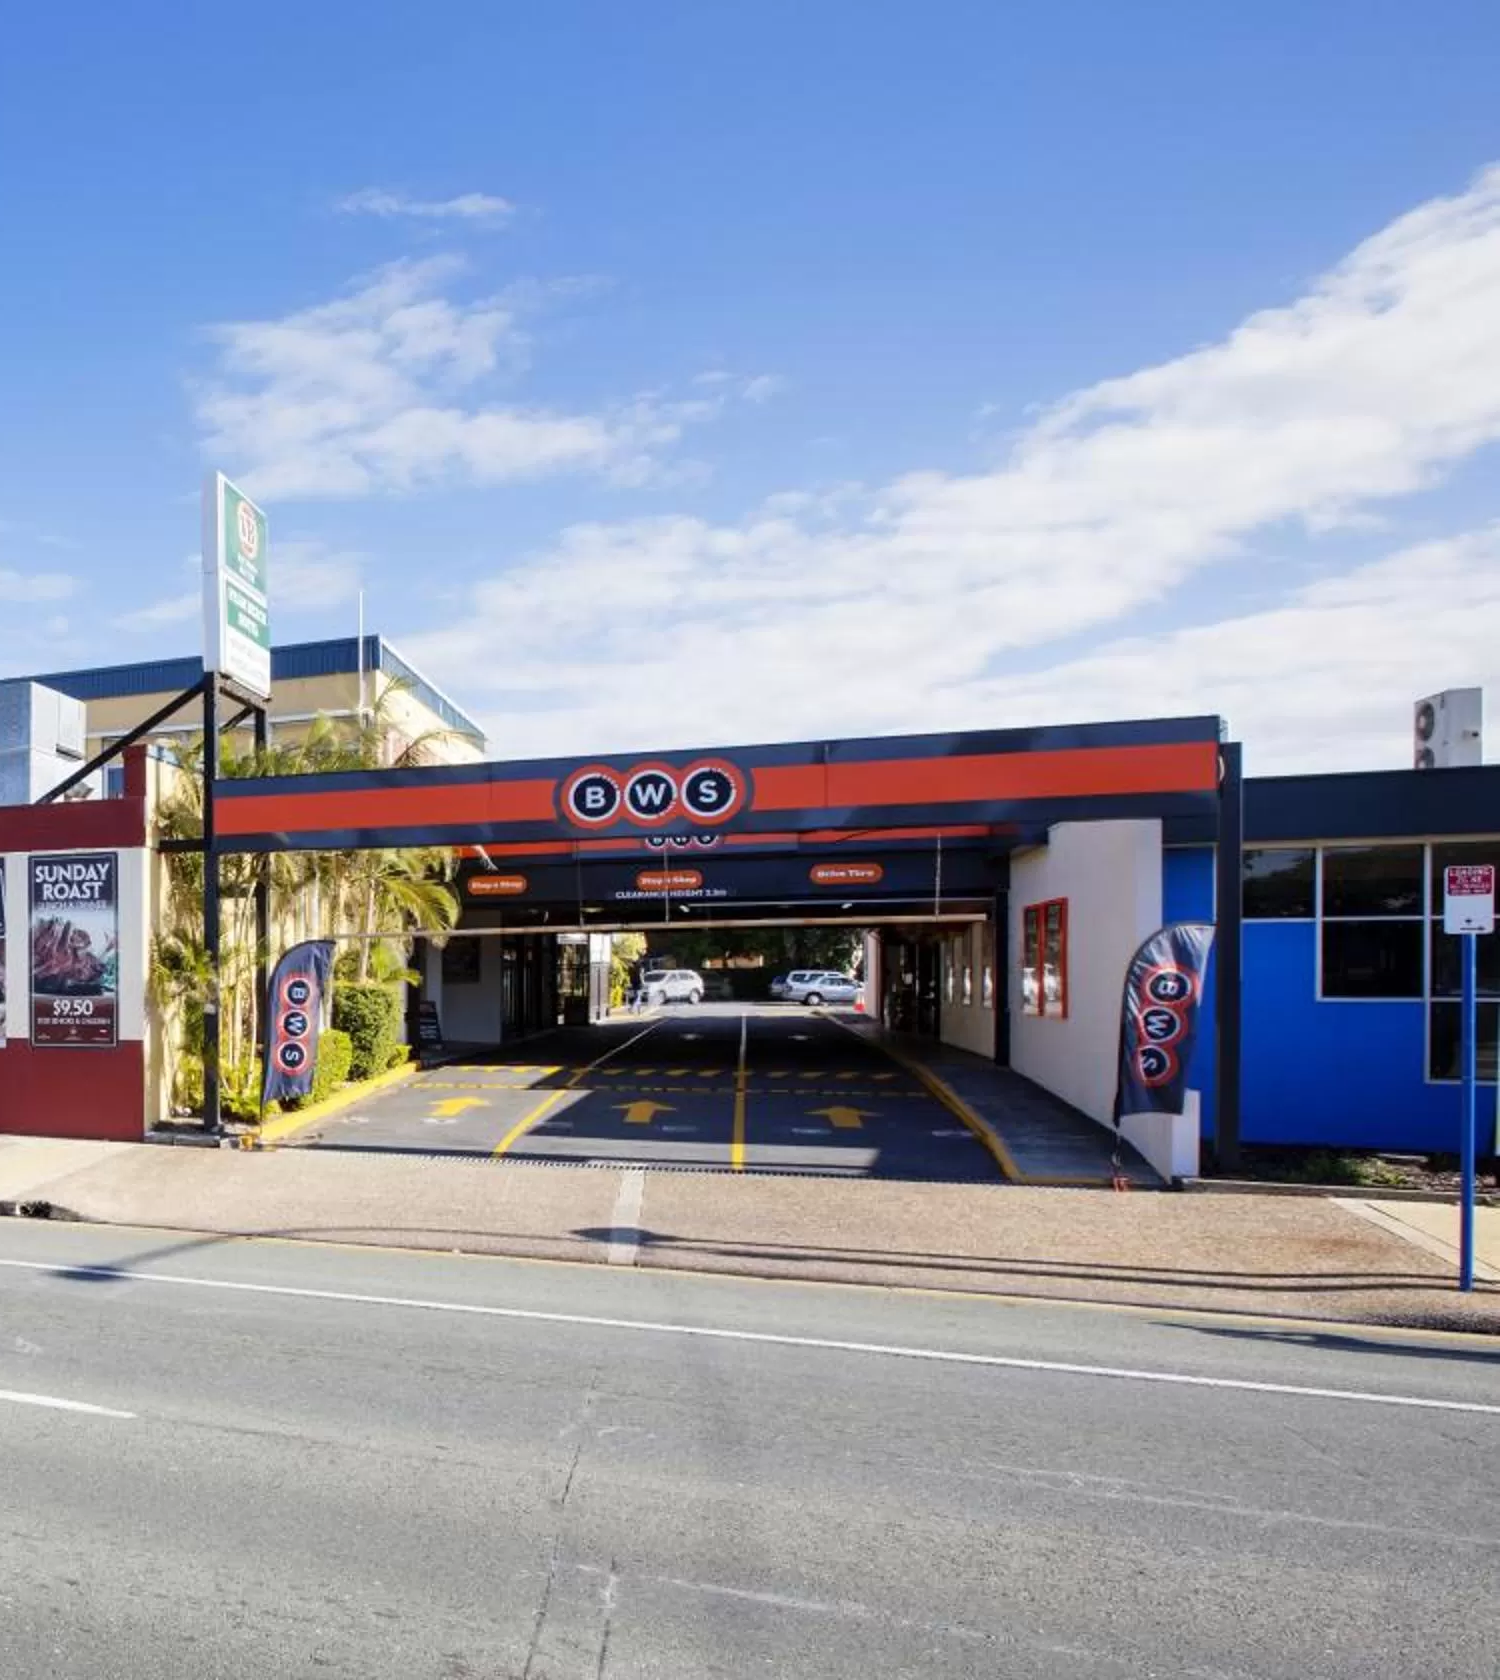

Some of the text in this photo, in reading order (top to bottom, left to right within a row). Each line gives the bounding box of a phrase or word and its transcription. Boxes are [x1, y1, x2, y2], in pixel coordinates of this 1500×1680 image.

[585, 779, 718, 809] BWS
[35, 863, 109, 883] SUNDAY
[43, 881, 103, 900] ROAST
[53, 998, 93, 1017] $9.50
